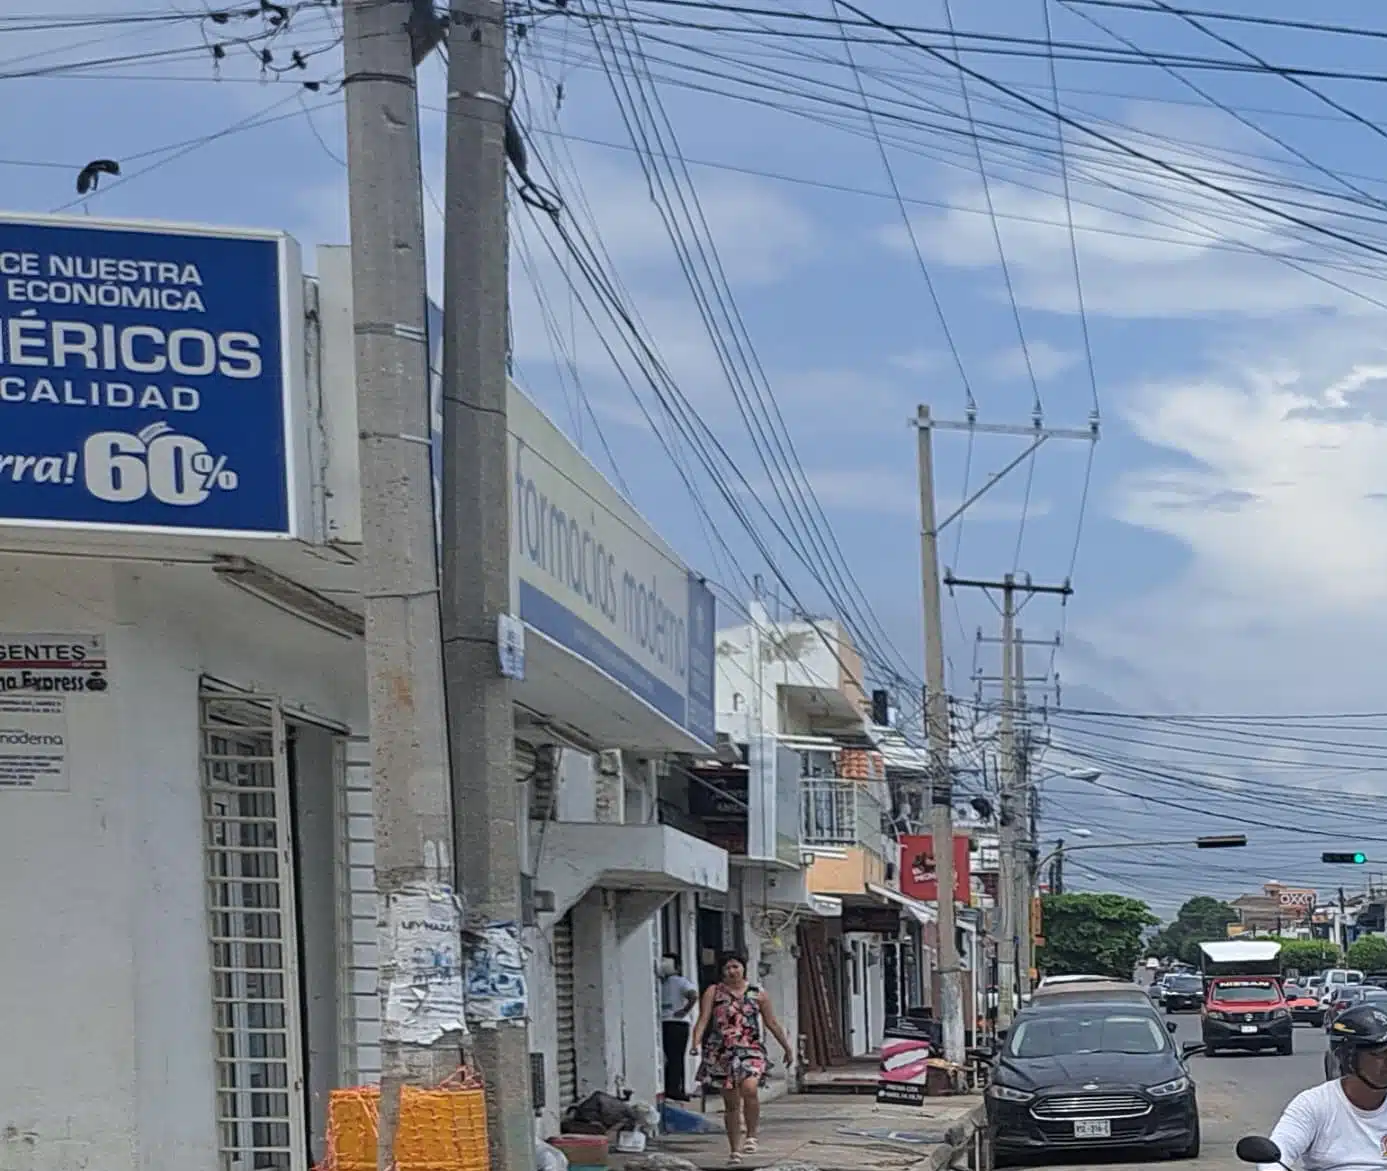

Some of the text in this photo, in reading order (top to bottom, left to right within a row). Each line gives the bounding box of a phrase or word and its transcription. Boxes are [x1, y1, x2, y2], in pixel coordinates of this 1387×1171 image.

[50, 255, 204, 286] NUESTRA
[8, 278, 206, 312] ECONÓMICA
[0, 308, 263, 379] ÉRICOS
[0, 377, 200, 412] CALIDAD
[84, 431, 239, 506] 60%
[22, 671, 84, 692] Express
